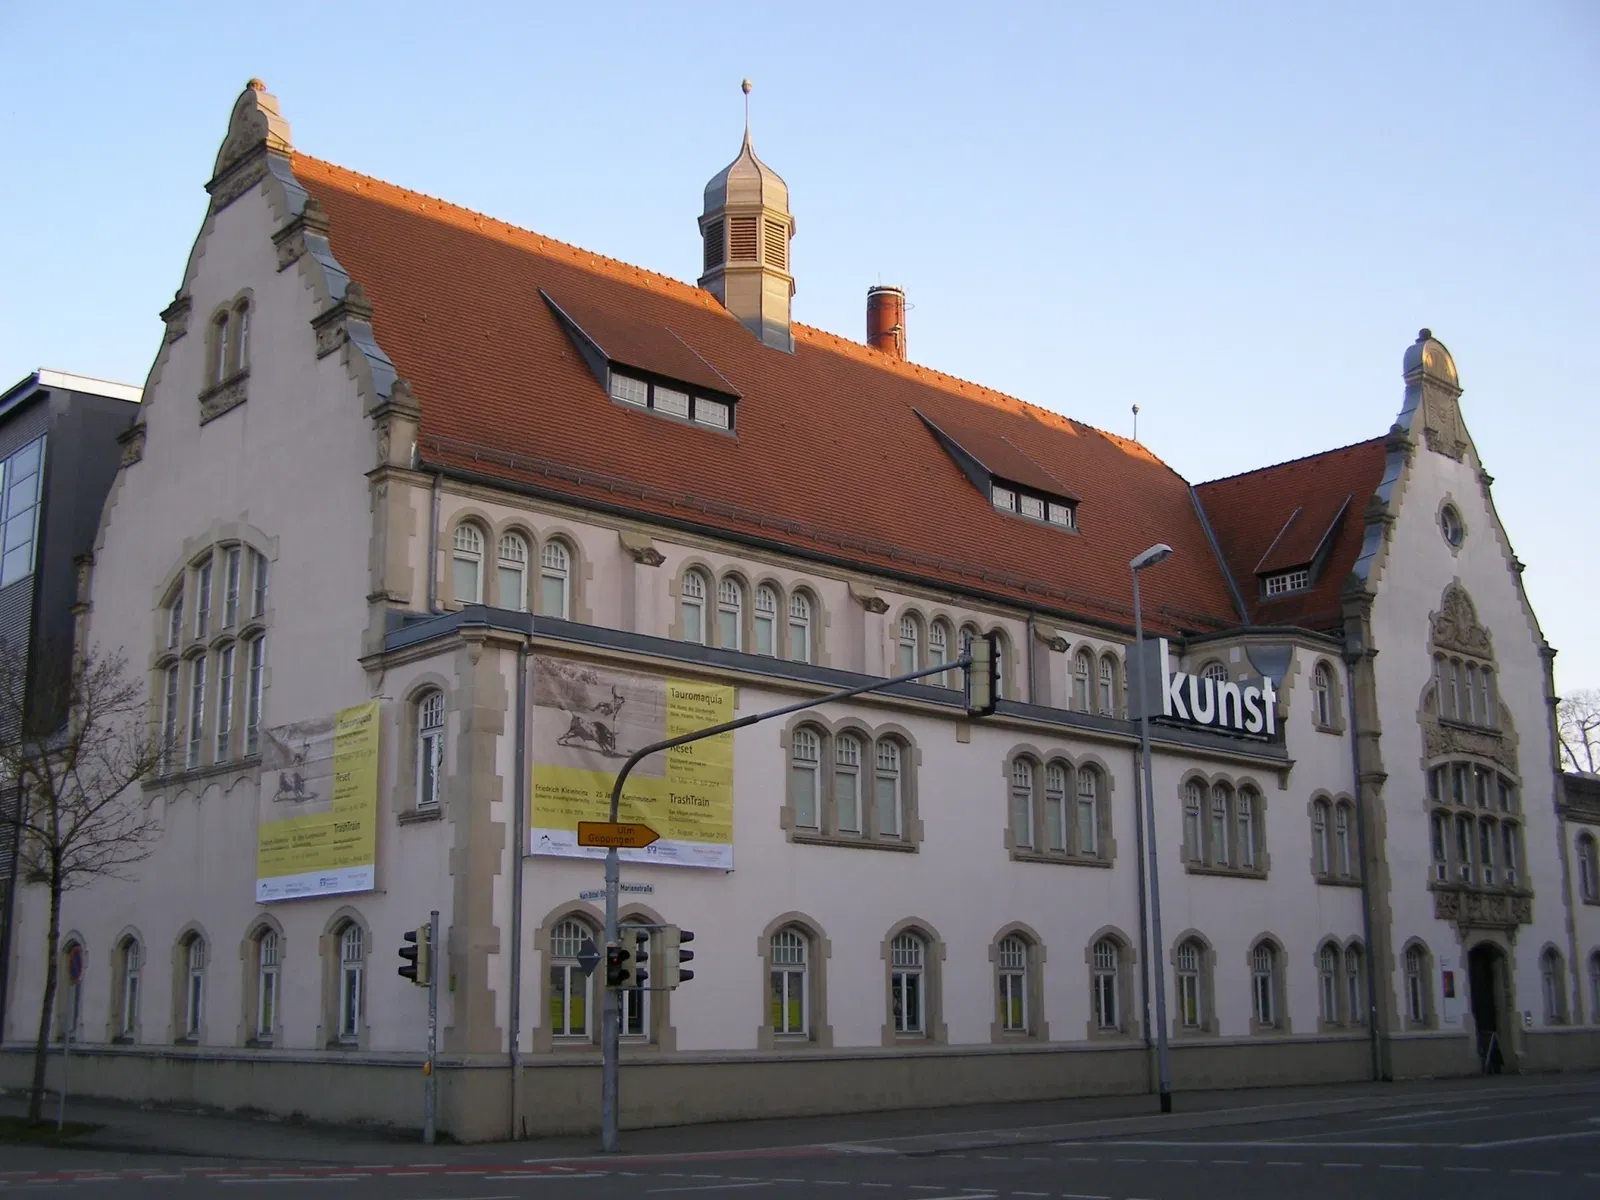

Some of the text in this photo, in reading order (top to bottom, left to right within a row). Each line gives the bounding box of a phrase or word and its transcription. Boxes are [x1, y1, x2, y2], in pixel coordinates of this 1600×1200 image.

[1159, 637, 1276, 735] kunst
[670, 687, 723, 705] Tauromaquia
[669, 792, 710, 807] TrashTrain
[617, 827, 635, 835] Ulm
